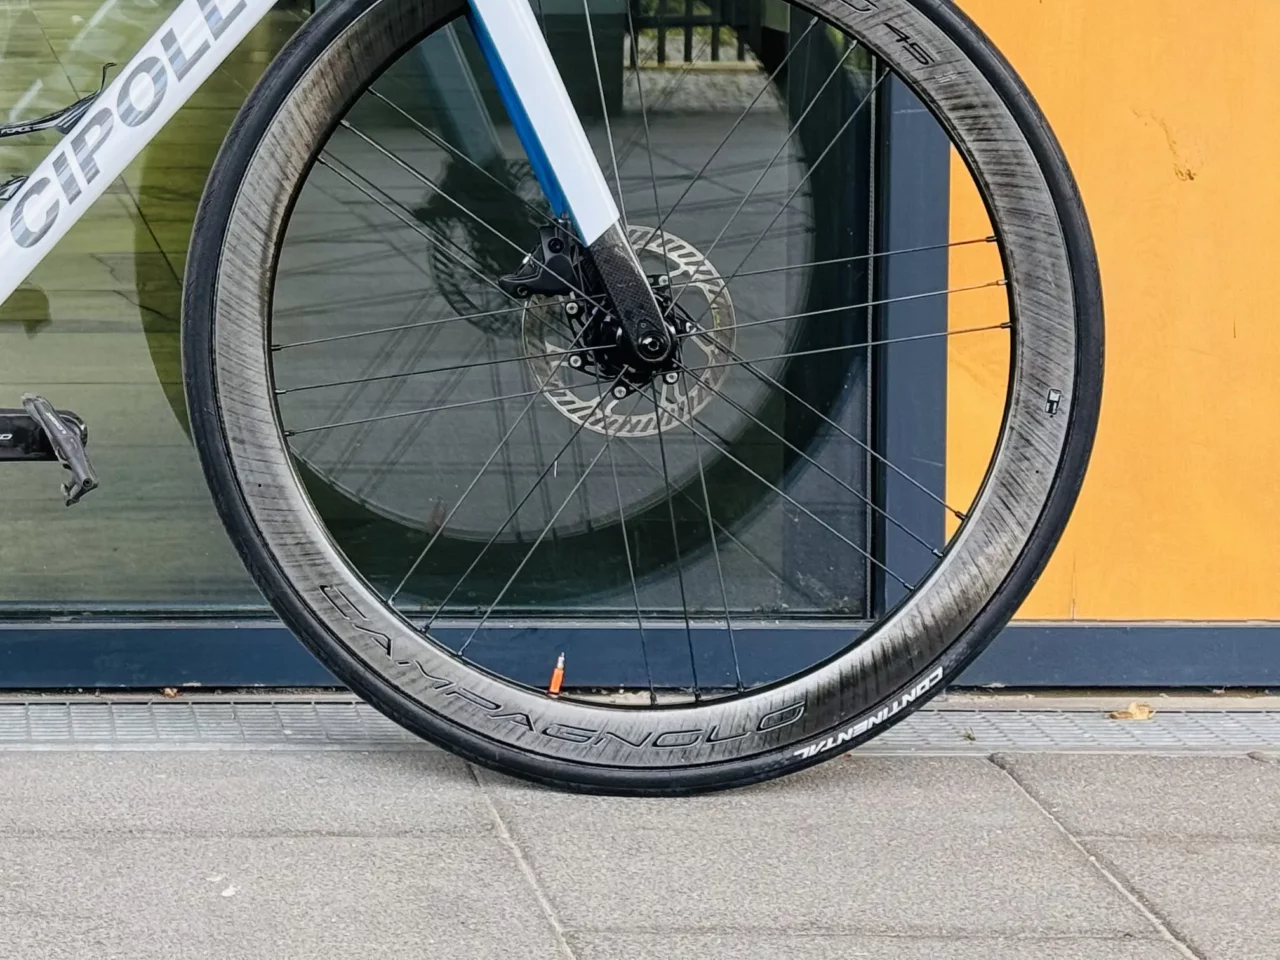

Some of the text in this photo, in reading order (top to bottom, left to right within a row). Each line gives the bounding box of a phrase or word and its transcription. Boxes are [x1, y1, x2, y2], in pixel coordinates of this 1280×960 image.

[883, 22, 936, 66] 45
[318, 585, 806, 749] CAMPAGNOLO
[793, 666, 944, 759] CONTINENTAL
